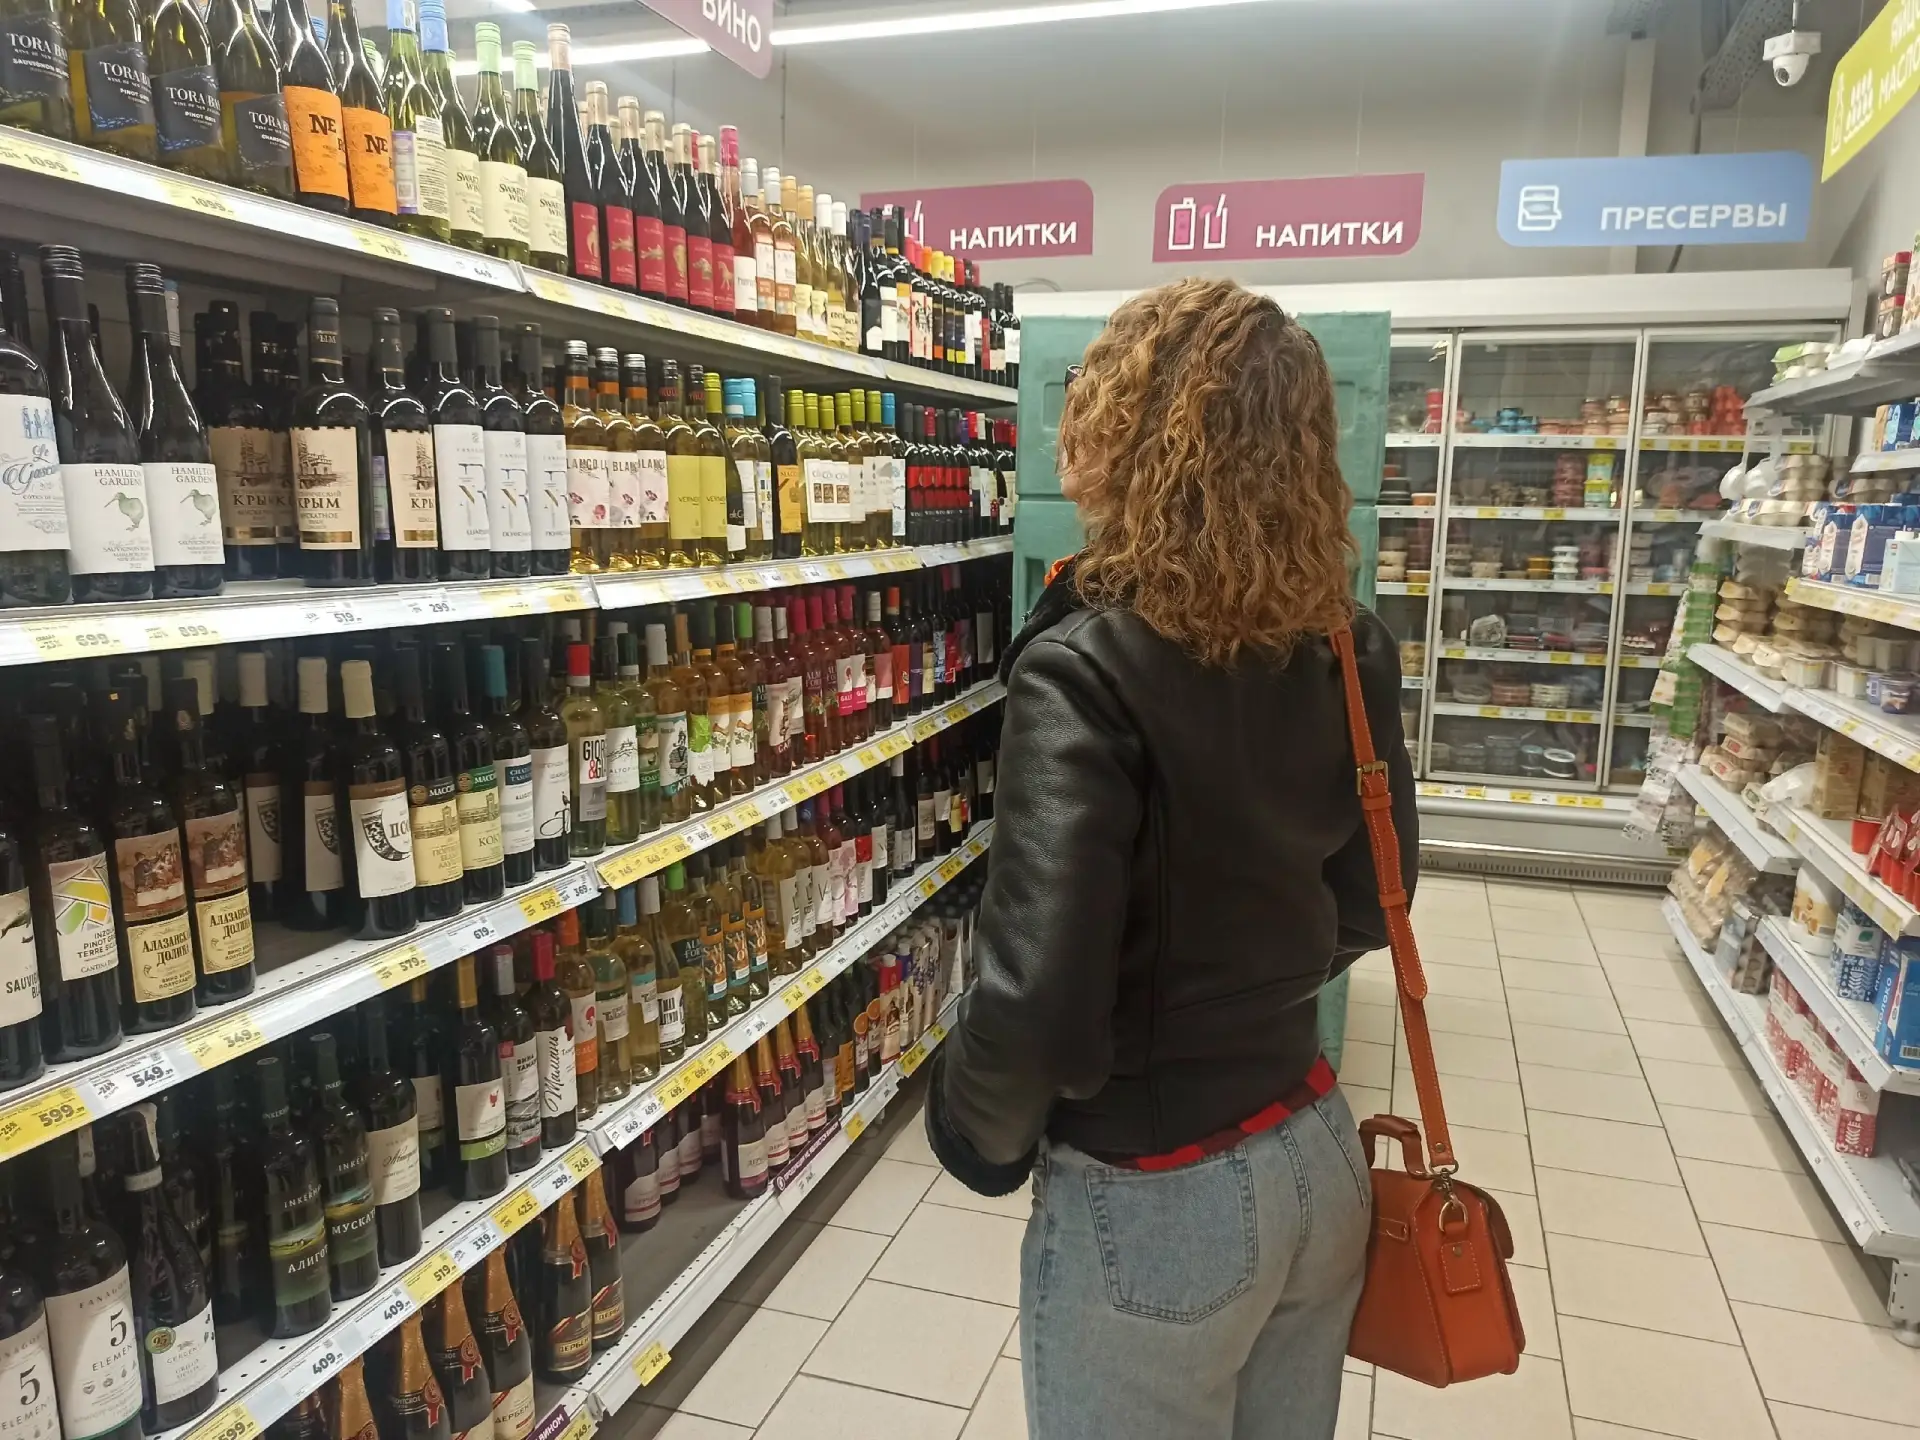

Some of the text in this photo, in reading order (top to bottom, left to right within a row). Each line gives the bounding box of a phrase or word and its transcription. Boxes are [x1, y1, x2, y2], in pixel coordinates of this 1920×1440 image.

[7, 32, 51, 53] TORA
[100, 61, 139, 80] TORA
[166, 86, 205, 105] TORA
[248, 111, 282, 130] TORA
[308, 113, 337, 134] NE
[365, 134, 388, 153] NE
[1600, 203, 1787, 231] ПРЕСЕРВЫ
[950, 222, 1077, 250] НАПИТКИ
[1255, 220, 1403, 248] НАПИТКИ
[429, 602, 450, 613] 299
[574, 884, 589, 897] 369
[540, 898, 556, 911] 399
[77, 947, 103, 959] TERRE
[84, 938, 106, 950] PINOT
[399, 956, 420, 972] 579
[1875, 977, 1892, 1032] МОЛОКО
[223, 1029, 252, 1048] 349
[132, 1066, 164, 1088] 549
[38, 1104, 74, 1127] 599
[574, 1156, 590, 1173] 249
[552, 1173, 568, 1190] 299
[517, 1200, 533, 1217] 425
[473, 1232, 492, 1251] 339
[383, 1299, 405, 1321] 409
[109, 1308, 127, 1347] 5
[312, 1352, 336, 1375] 409
[19, 1365, 41, 1406] 5
